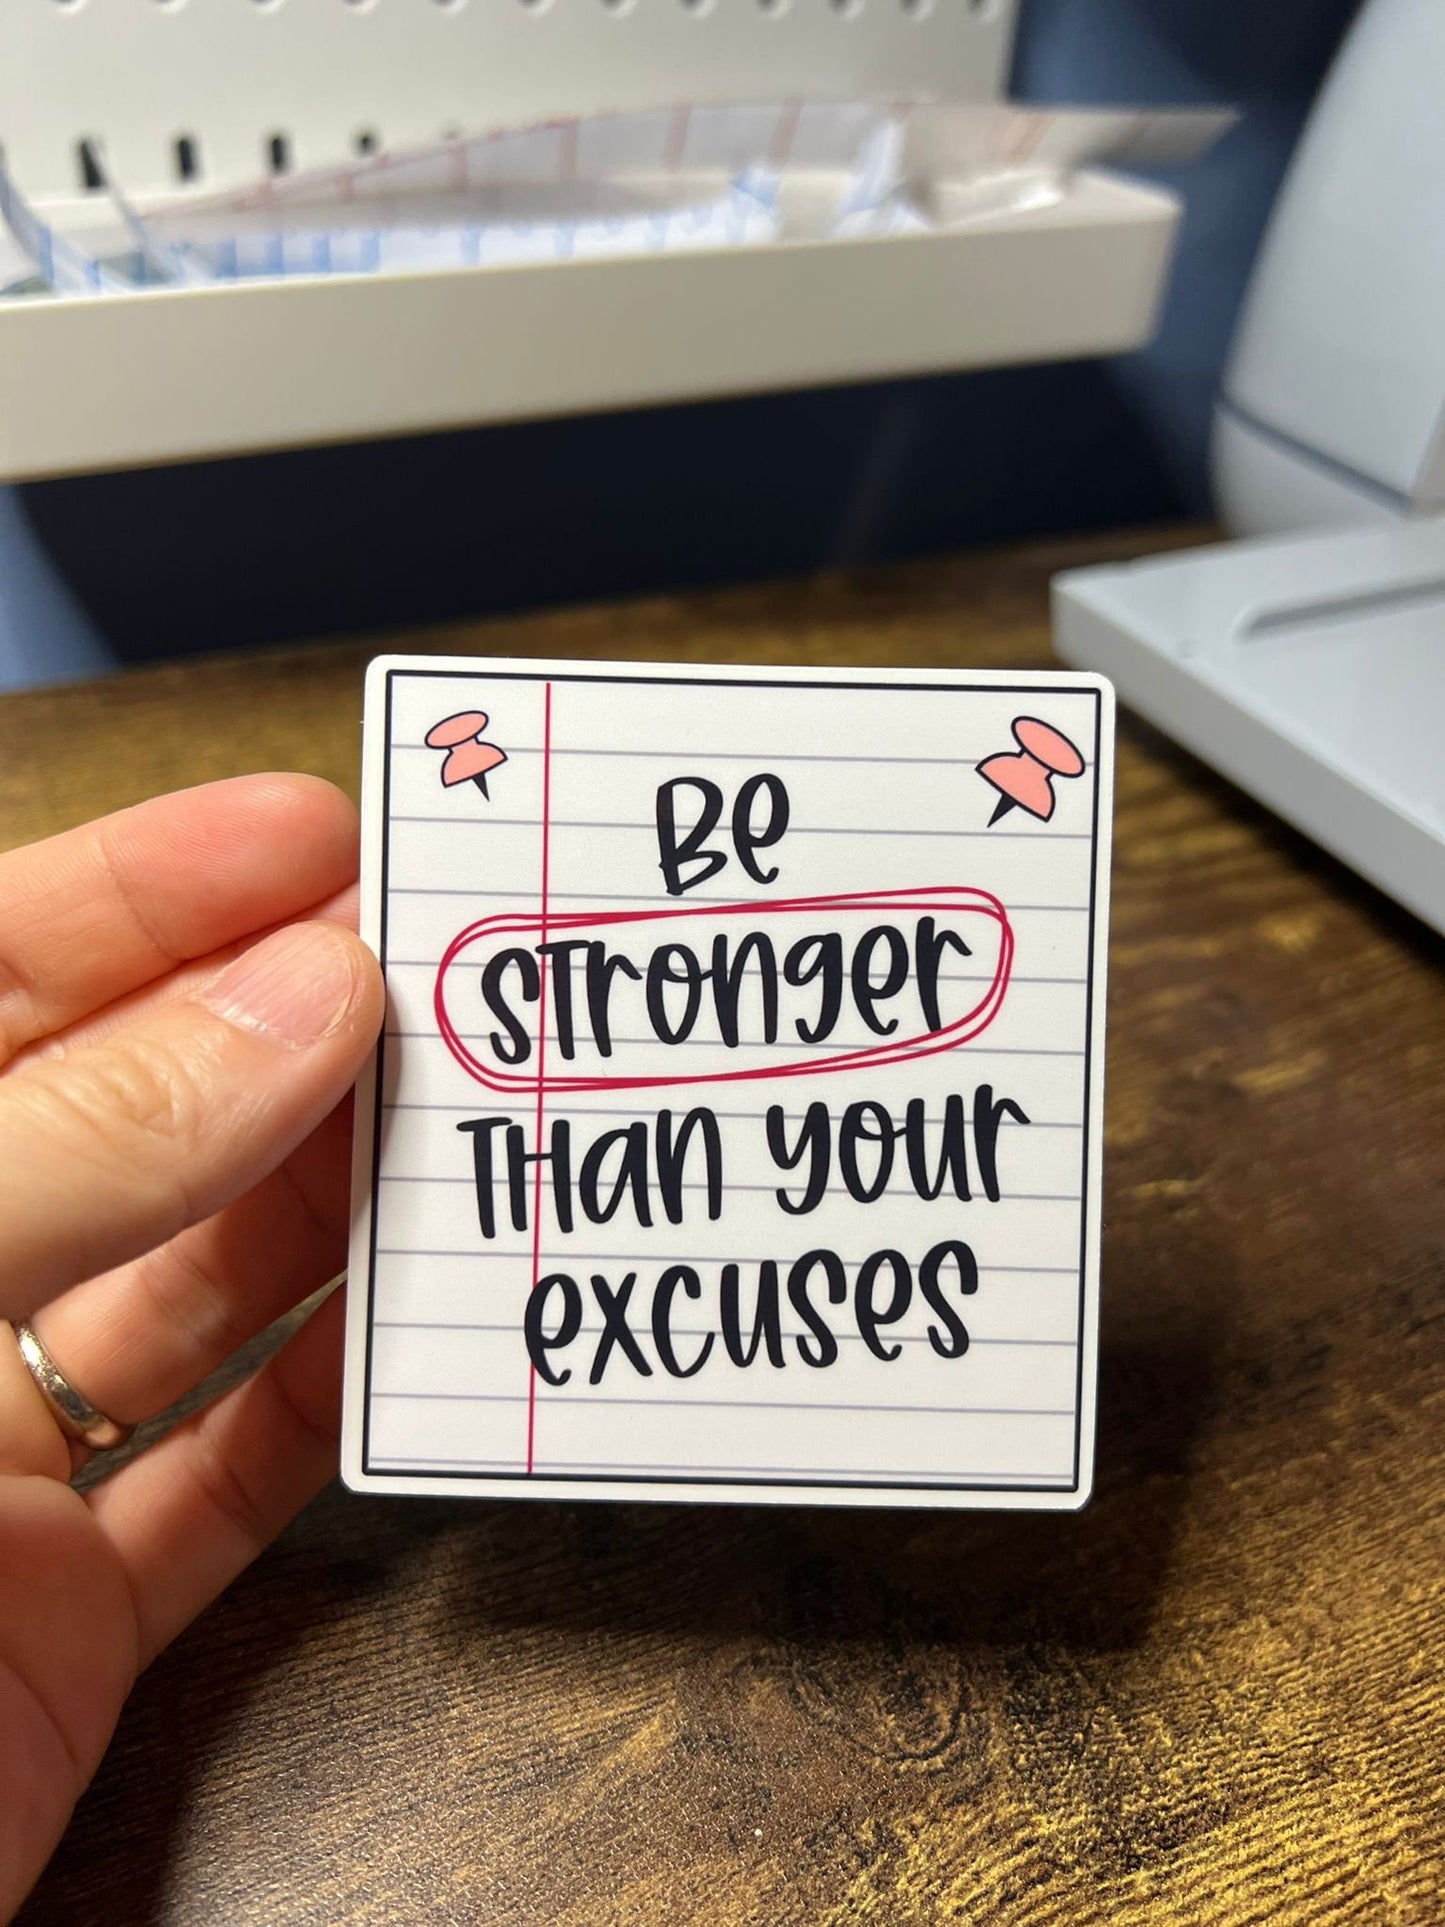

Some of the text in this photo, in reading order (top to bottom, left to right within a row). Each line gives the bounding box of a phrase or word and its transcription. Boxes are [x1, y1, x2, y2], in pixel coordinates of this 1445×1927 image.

[656, 774, 789, 896] Be
[766, 1084, 1030, 1215] your
[524, 1240, 978, 1386] excuses
